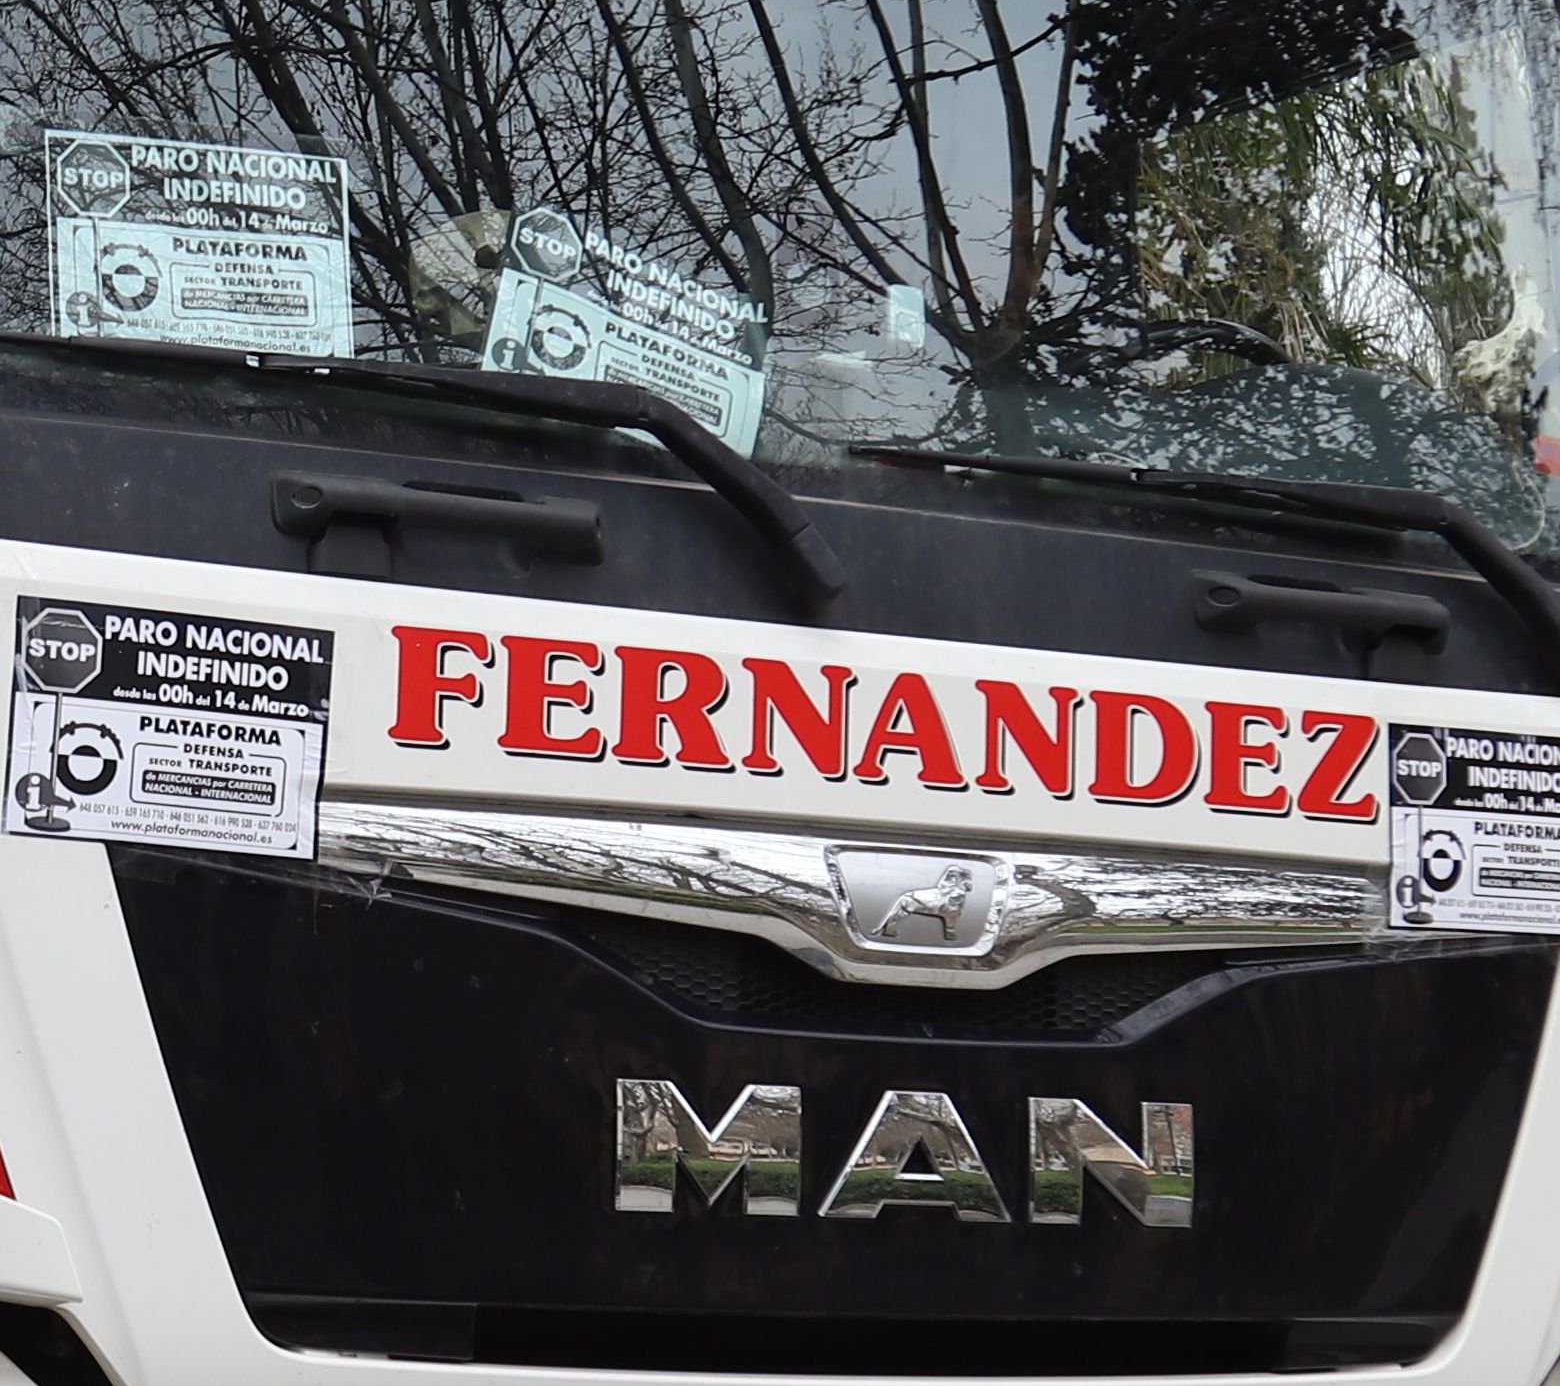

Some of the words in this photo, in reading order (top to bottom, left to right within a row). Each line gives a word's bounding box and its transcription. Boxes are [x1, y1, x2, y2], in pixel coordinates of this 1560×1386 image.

[131, 143, 199, 172] PARO
[206, 150, 336, 184] NACIONAL
[63, 167, 124, 189] STOP
[162, 175, 306, 212] INDEFINIDO
[185, 206, 219, 226] 00h
[239, 212, 259, 229] 14
[274, 215, 328, 234] Marzo
[172, 236, 307, 263] PLATAFORMA
[519, 227, 578, 259] STOP
[214, 261, 273, 276] DEFENSA
[220, 274, 302, 291] TRANSPORTE
[585, 232, 643, 274] PARO
[649, 264, 768, 323] NACIONAL
[607, 270, 735, 339] INDEFINIDO
[605, 322, 729, 381] PLATAFORMA
[700, 335, 753, 365] Marzo
[641, 353, 696, 381] DEFENSA
[645, 367, 720, 402] TRANSPORTE
[28, 637, 96, 663] STOP
[103, 614, 178, 647] PARO
[185, 624, 325, 663] NACIONAL
[136, 650, 289, 691] INDEFINIDO
[113, 685, 141, 699] desde
[142, 689, 157, 701] las
[158, 684, 194, 704] 00h
[195, 695, 210, 706] del
[214, 690, 236, 709] 14
[237, 700, 249, 710] de
[251, 694, 309, 717] Marzo
[138, 716, 282, 745] PLATAFORMA
[388, 624, 1379, 823] FERNANDEZ
[183, 743, 245, 759] DEFENSA
[1446, 736, 1493, 760] PARO
[148, 757, 182, 767] SECTOR
[188, 759, 272, 776] TRANSPORTE
[1396, 758, 1442, 778] STOP
[144, 782, 192, 796] NACIONAL
[200, 787, 271, 803] INTERNACIONAL
[145, 772, 156, 780] de
[212, 778, 226, 789] por
[227, 779, 272, 792] CARRETERA
[1482, 792, 1507, 809] 00h
[1520, 796, 1533, 812] 14
[111, 819, 272, 844] www.plataformanacional.es
[614, 1077, 1195, 1230] MAN
